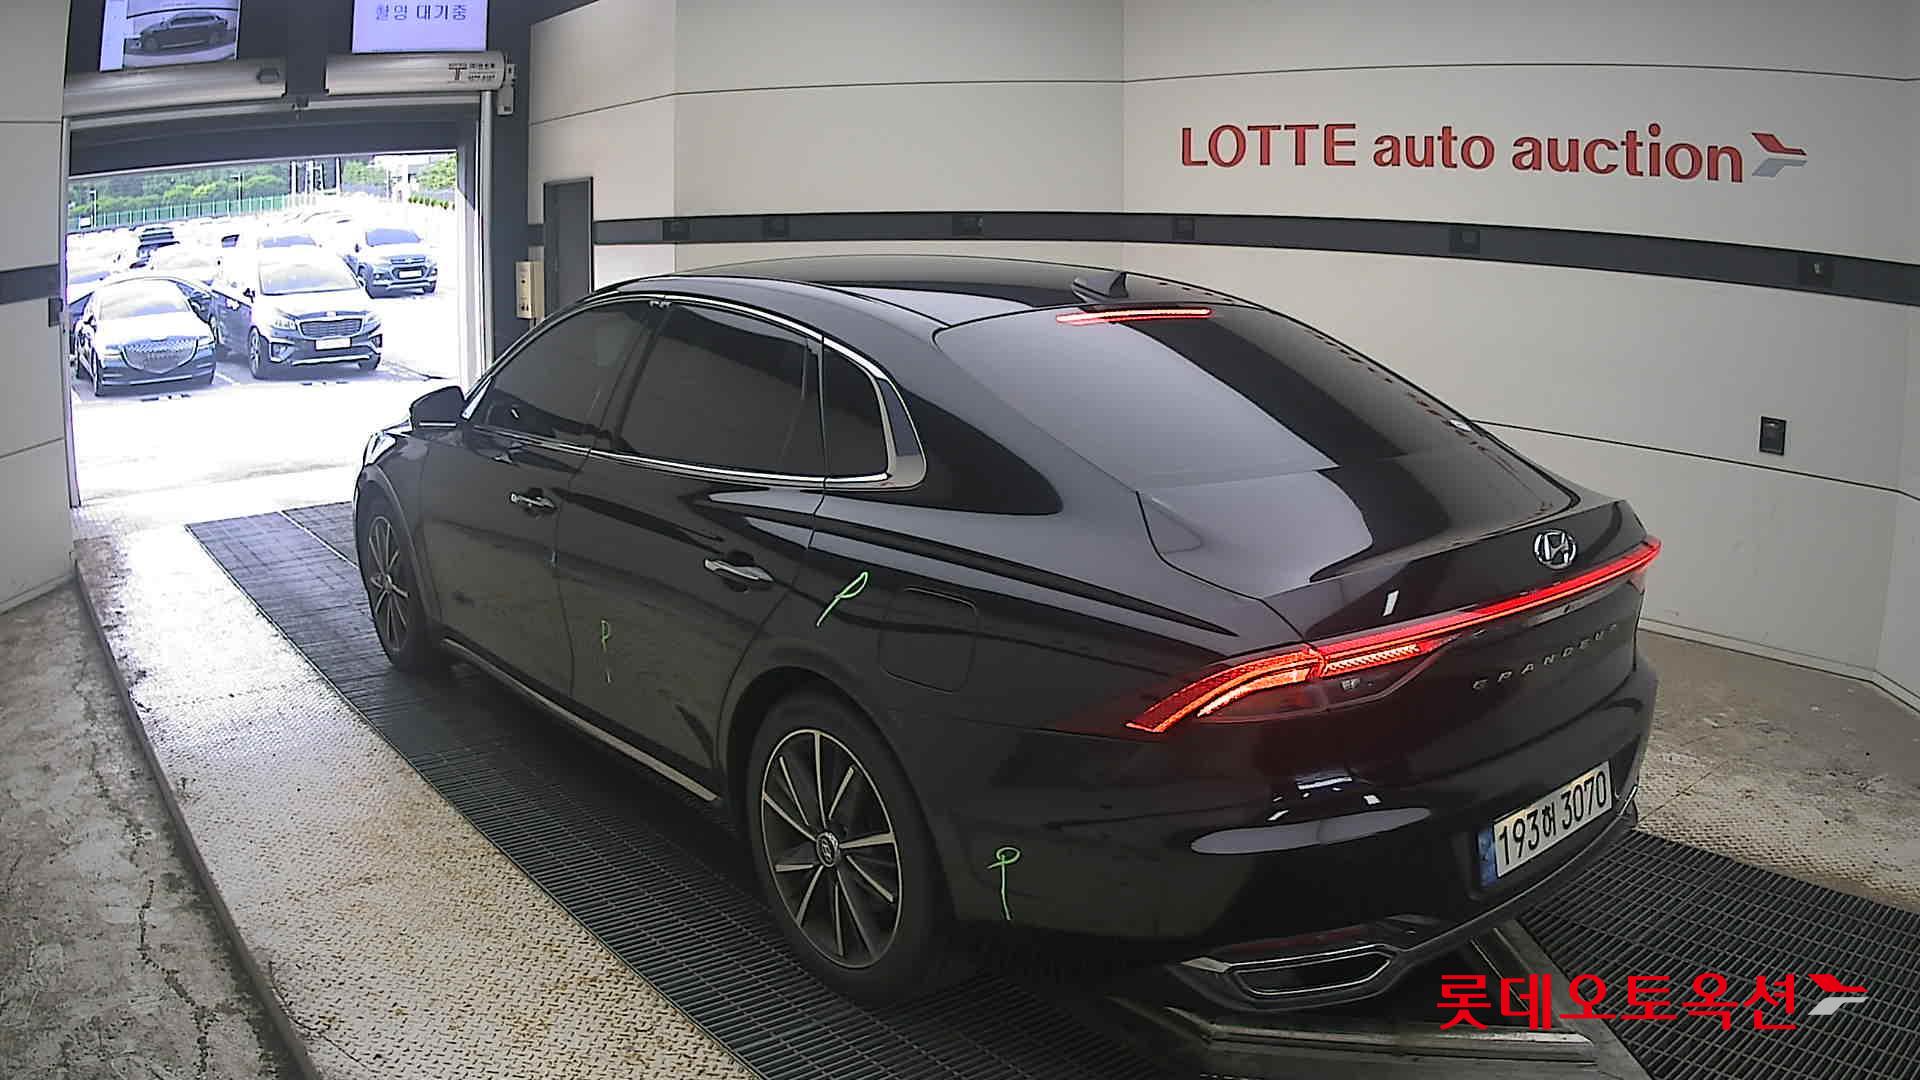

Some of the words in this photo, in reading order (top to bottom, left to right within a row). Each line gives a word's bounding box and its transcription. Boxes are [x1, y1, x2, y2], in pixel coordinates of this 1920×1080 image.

[416, 4, 467, 21] 대기중
[1181, 124, 1357, 168] LOTTE
[1372, 125, 1496, 170] auto
[1511, 122, 1744, 184] auction
[1498, 801, 1557, 866] 193허
[1560, 770, 1607, 830] 3070
